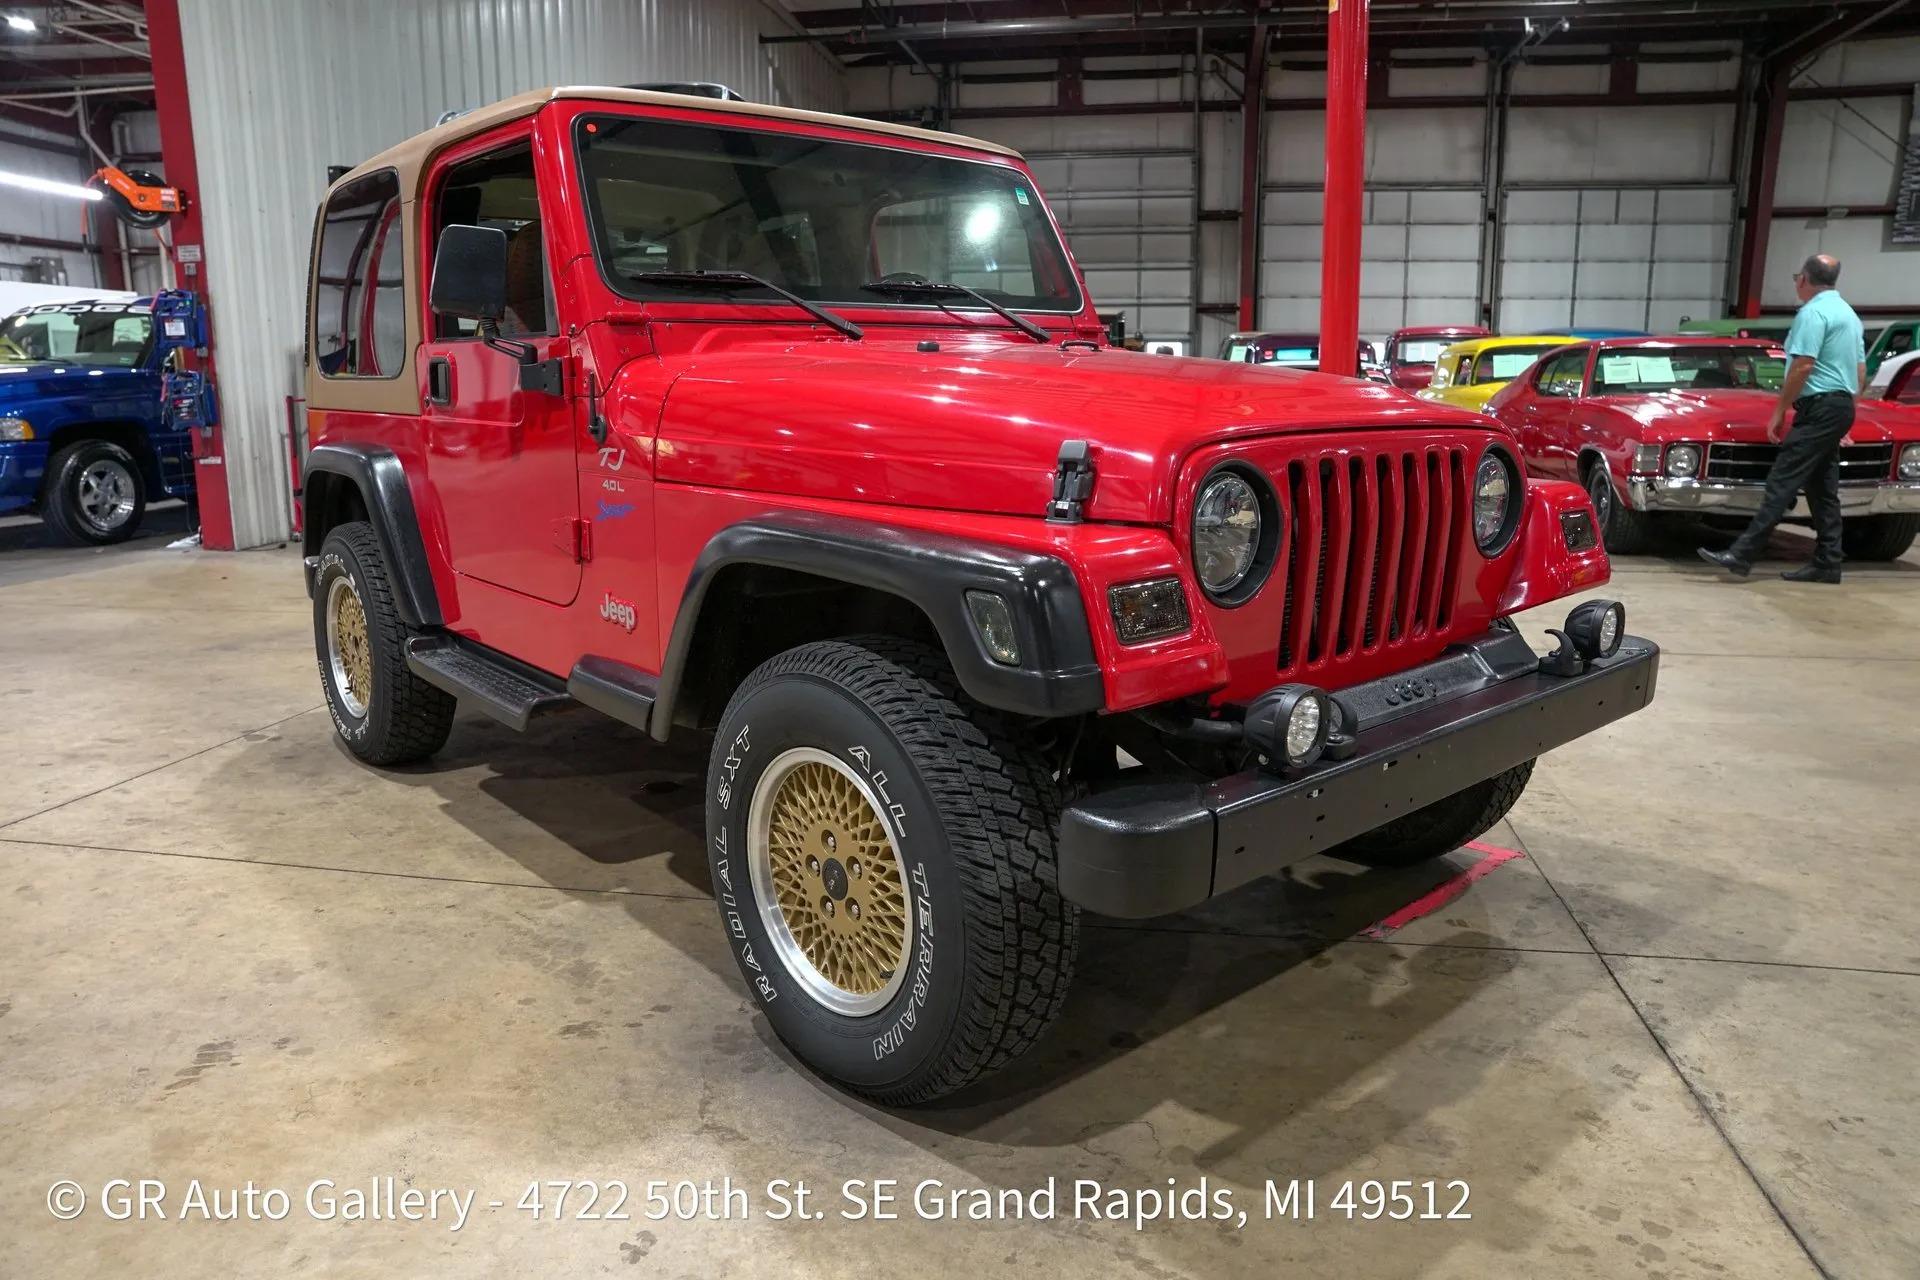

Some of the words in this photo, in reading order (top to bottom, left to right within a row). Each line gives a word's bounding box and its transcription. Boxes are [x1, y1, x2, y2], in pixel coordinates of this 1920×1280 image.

[599, 447, 626, 471] TJ
[600, 592, 637, 632] Jeep
[716, 724, 750, 810] SXT
[848, 745, 907, 838] ALL
[715, 825, 778, 1003] RADIAL
[873, 861, 935, 1062] TERRAIN
